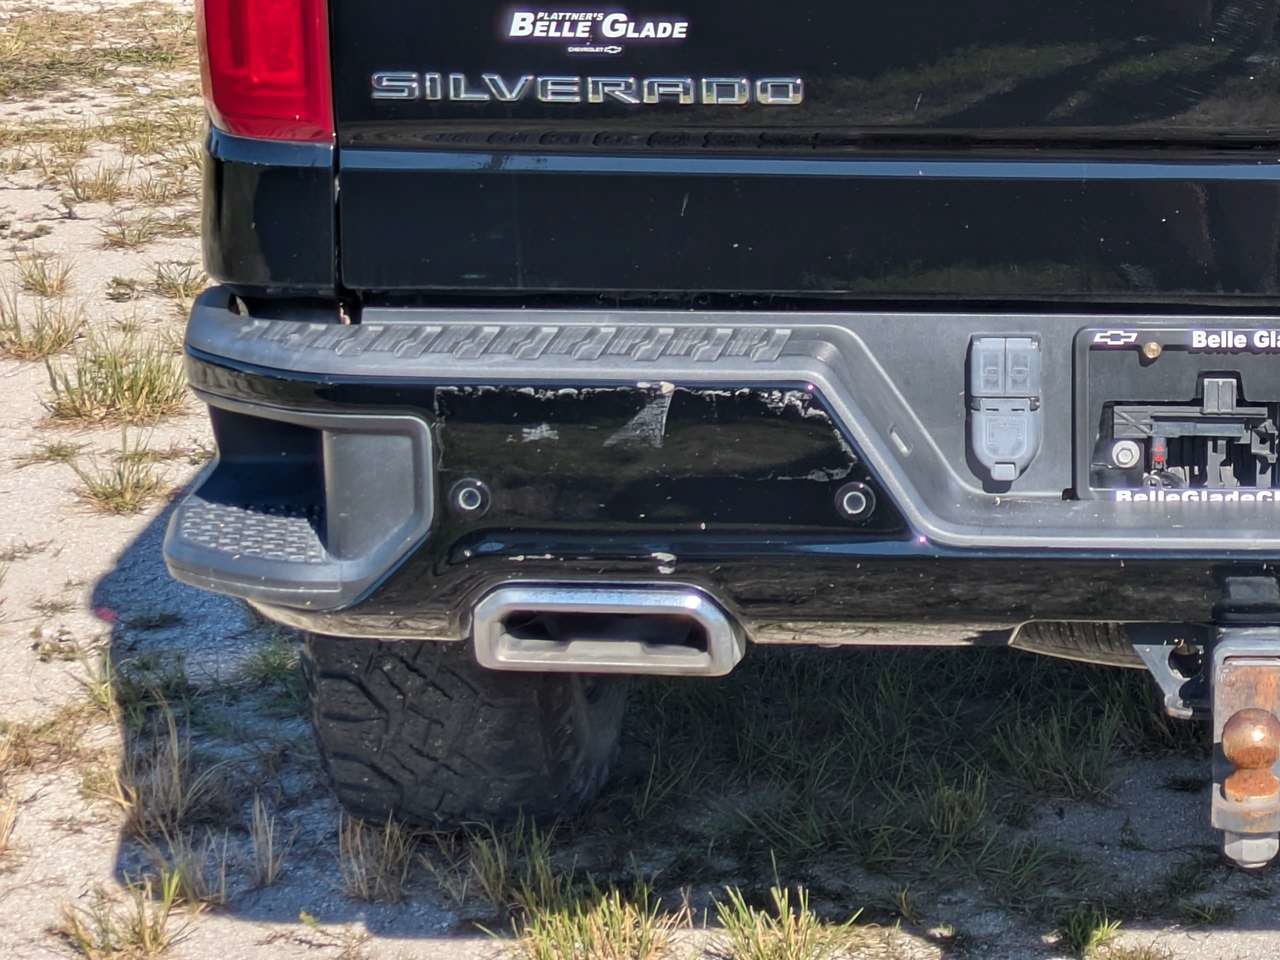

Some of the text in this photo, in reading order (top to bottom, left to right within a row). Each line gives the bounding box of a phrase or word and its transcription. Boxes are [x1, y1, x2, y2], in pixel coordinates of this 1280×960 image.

[509, 11, 689, 39] BELLE GLADE
[536, 12, 604, 21] PLATTNER'S
[371, 71, 804, 106] SILVERADO
[1192, 330, 1247, 348] Belle
